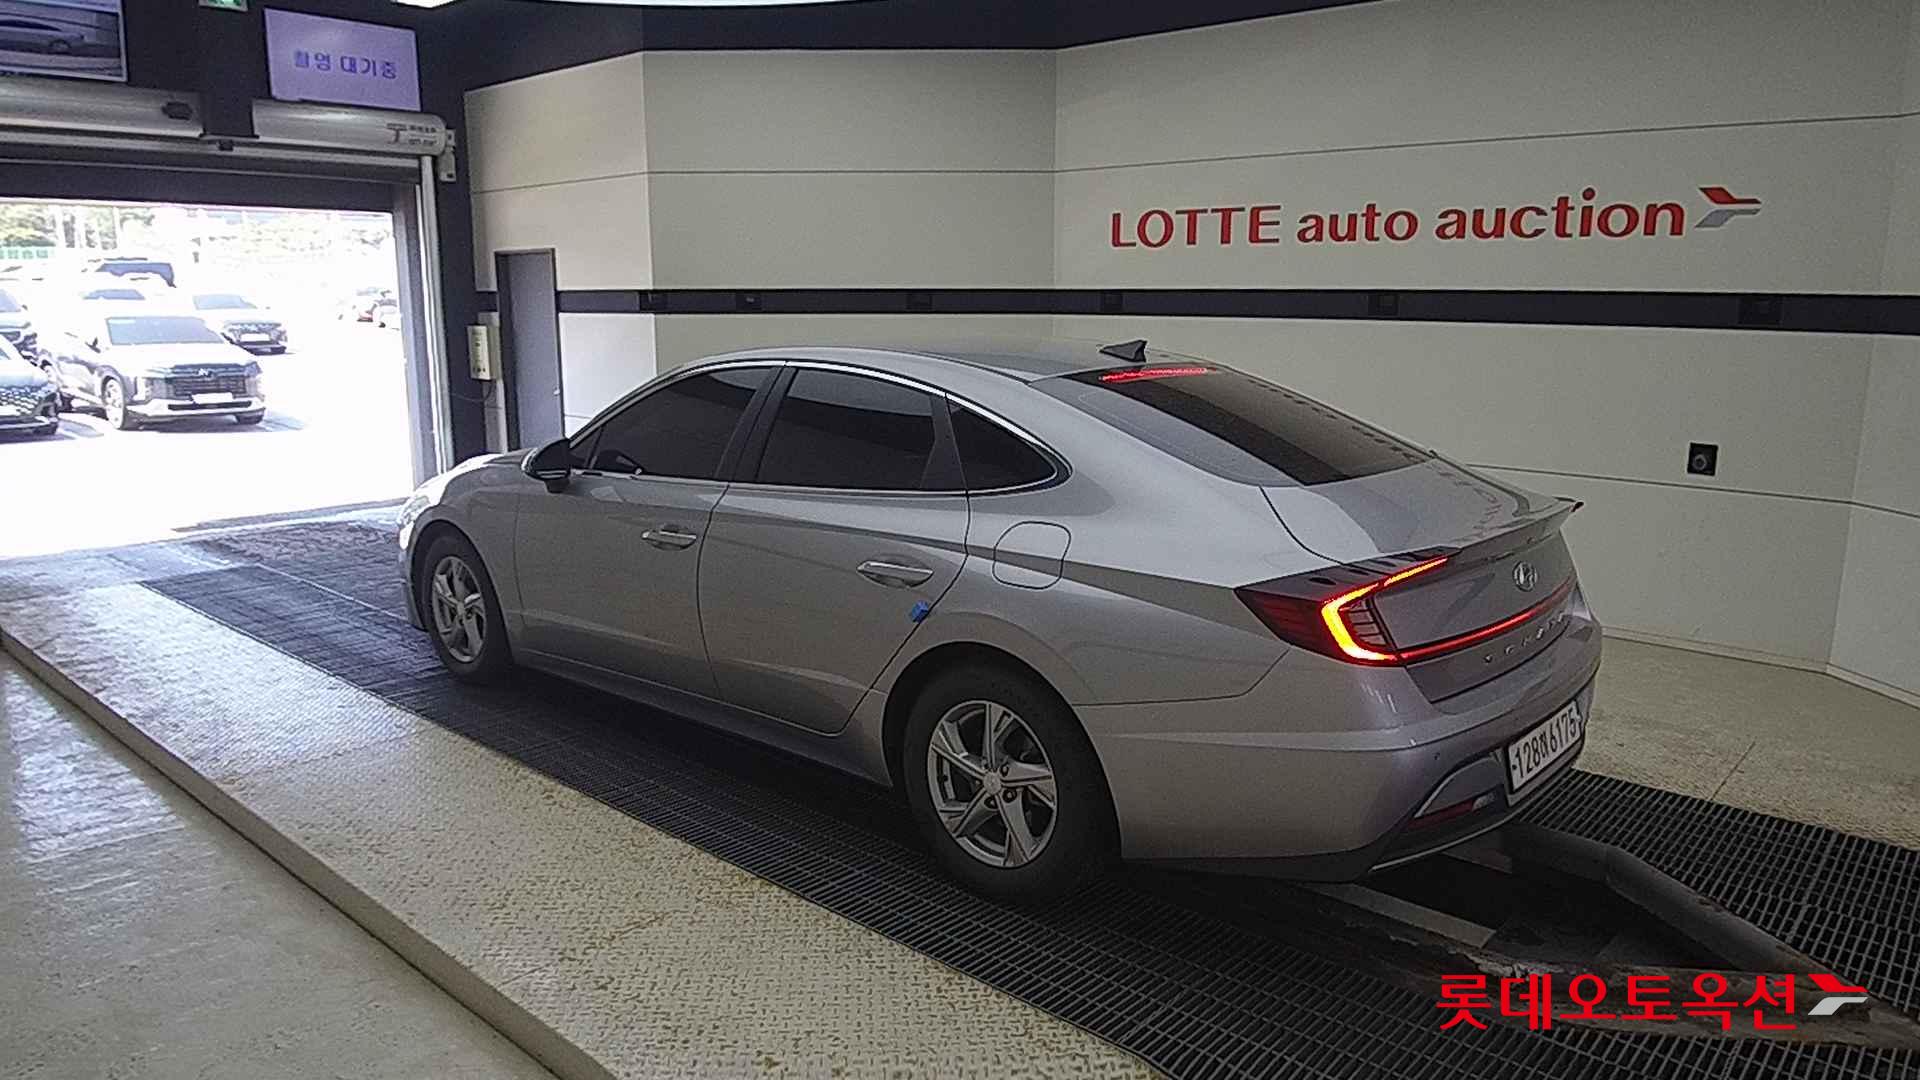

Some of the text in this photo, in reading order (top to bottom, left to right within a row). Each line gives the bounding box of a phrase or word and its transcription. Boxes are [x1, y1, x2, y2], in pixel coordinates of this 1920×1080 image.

[340, 55, 397, 79] 대기중
[1111, 187, 1685, 248] LOTTE auto auction
